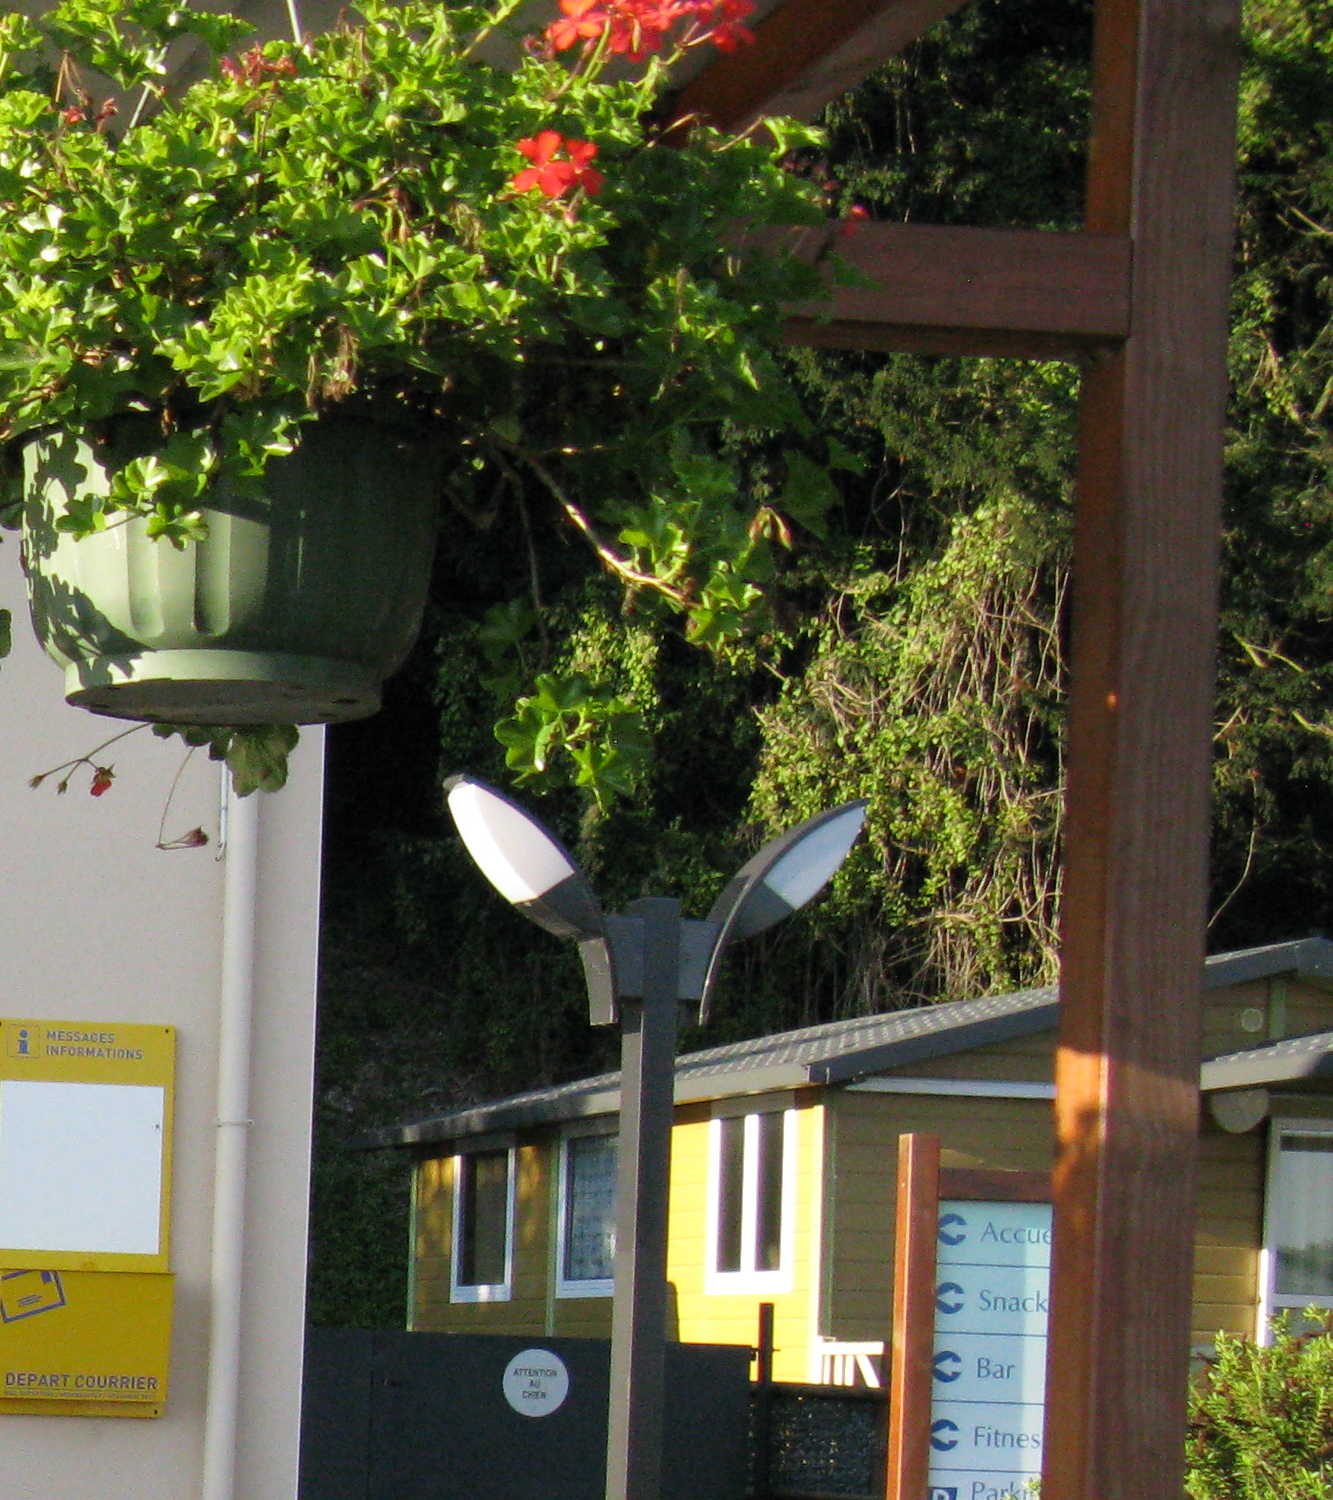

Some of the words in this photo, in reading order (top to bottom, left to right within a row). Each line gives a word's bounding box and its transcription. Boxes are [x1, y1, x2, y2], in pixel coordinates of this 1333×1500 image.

[46, 1029, 115, 1044] MESSAGES
[46, 1044, 143, 1060] INFORMATIONS
[980, 1221, 1052, 1245] Accue
[979, 1289, 1049, 1313] Snack
[513, 1368, 557, 1377] ATTENTION
[976, 1357, 1015, 1379] Bar
[5, 1372, 71, 1387] DEPART
[74, 1374, 158, 1390] COURRIER
[522, 1391, 546, 1399] CHIEN
[974, 1425, 1041, 1449] Fitnes
